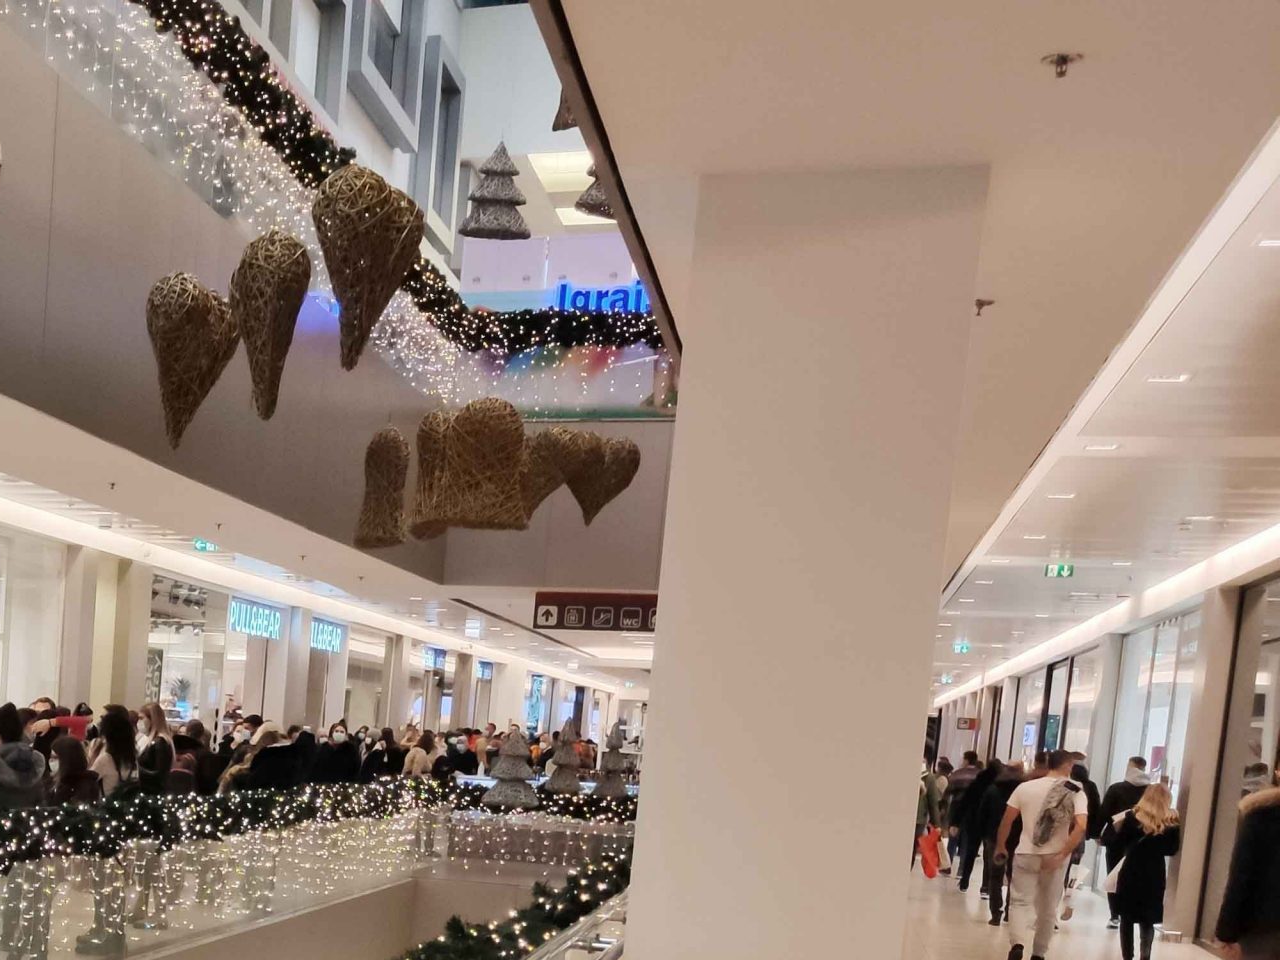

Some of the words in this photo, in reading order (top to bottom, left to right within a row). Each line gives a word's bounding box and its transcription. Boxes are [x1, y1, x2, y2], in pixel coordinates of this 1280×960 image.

[229, 601, 281, 640] PULL&BEAR
[622, 618, 639, 626] WC
[310, 621, 341, 653] LL&BEAR
